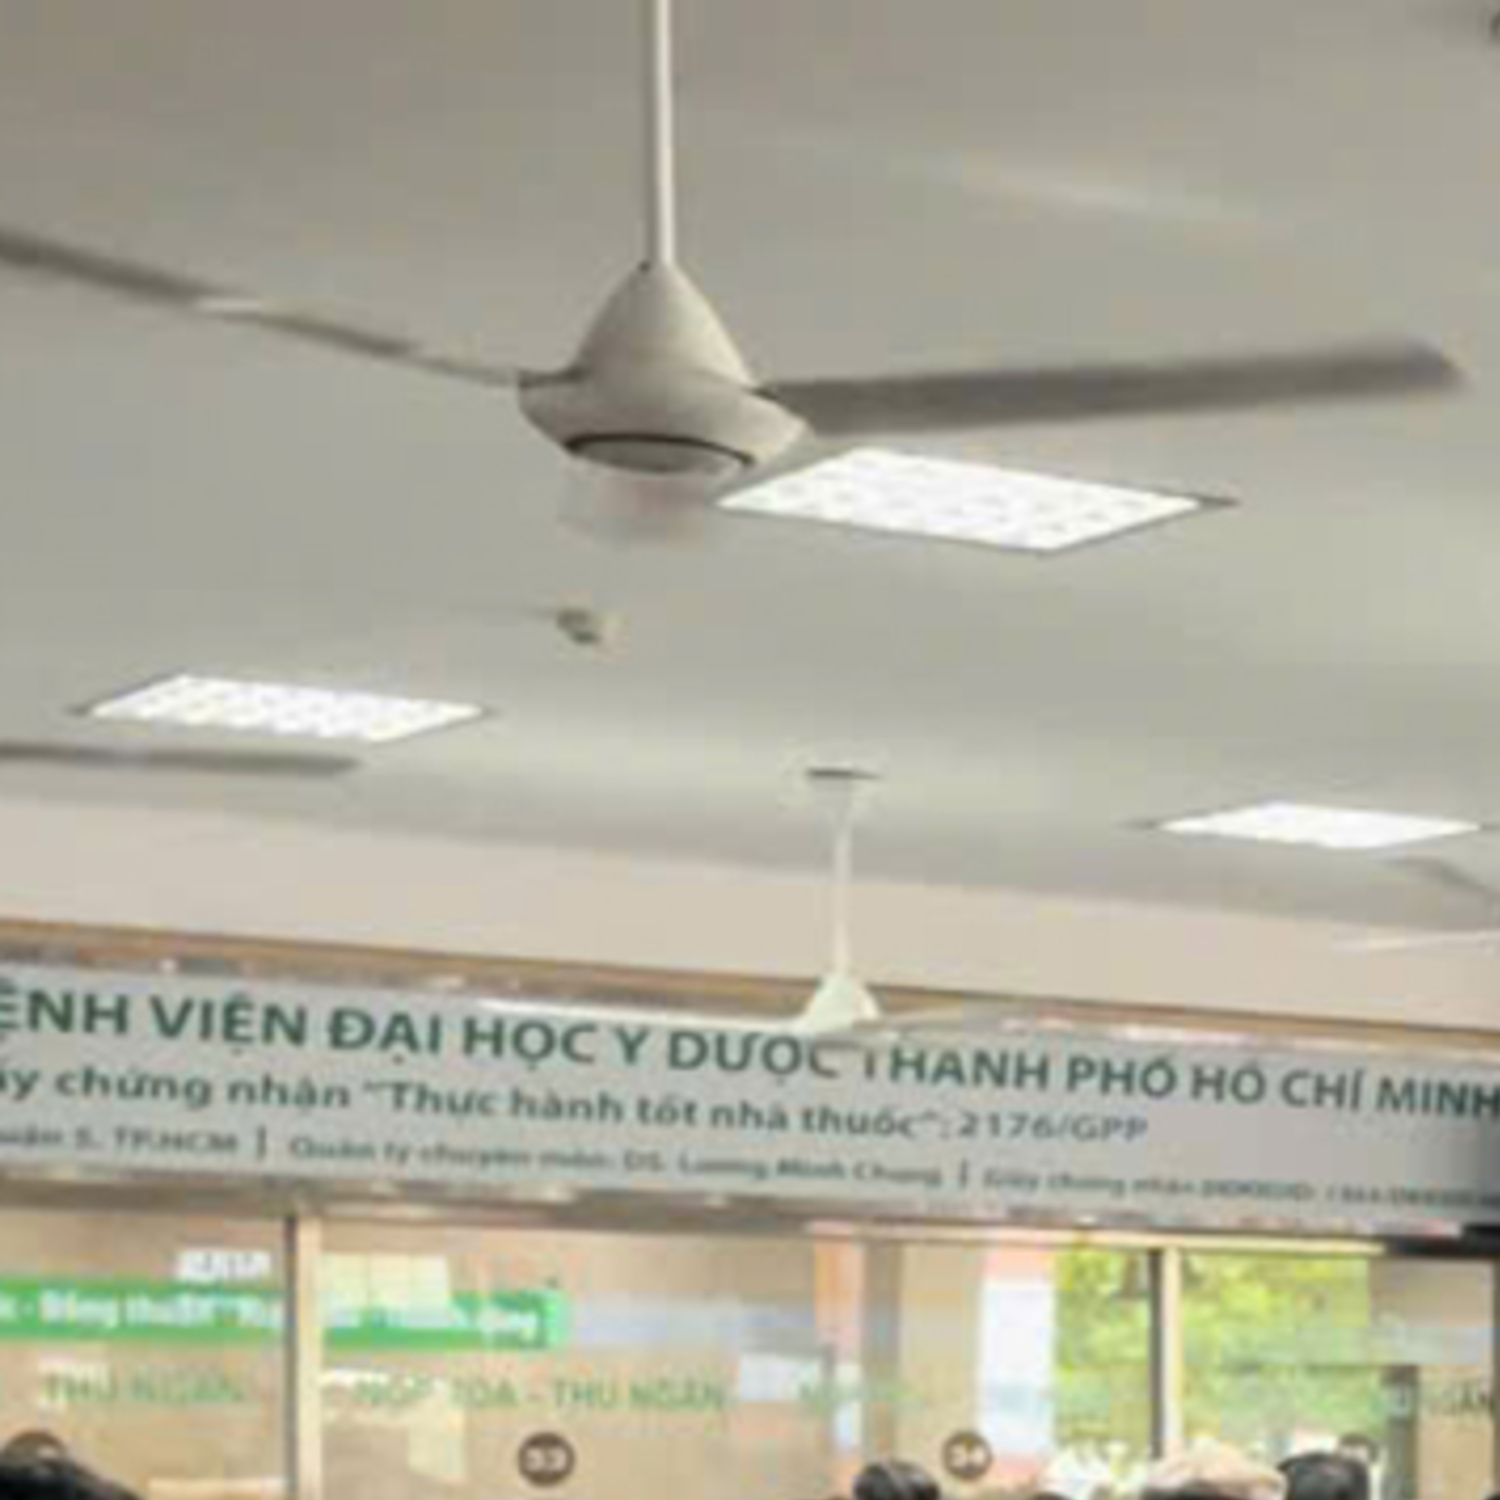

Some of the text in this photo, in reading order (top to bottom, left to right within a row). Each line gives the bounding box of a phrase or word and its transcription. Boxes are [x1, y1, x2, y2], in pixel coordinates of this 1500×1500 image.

[150, 992, 308, 1057] VIỆN
[328, 1007, 441, 1065] ĐẠI
[462, 1017, 598, 1071] HỌC
[613, 1027, 651, 1066] Y
[1280, 1066, 1367, 1112] CHÍ
[54, 1064, 213, 1109] chứng
[226, 1074, 351, 1114] nhận
[510, 1087, 626, 1125] hành
[635, 1092, 699, 1127] tốt
[708, 1098, 789, 1132] nhà
[957, 1110, 1148, 1143] 2176/GPP
